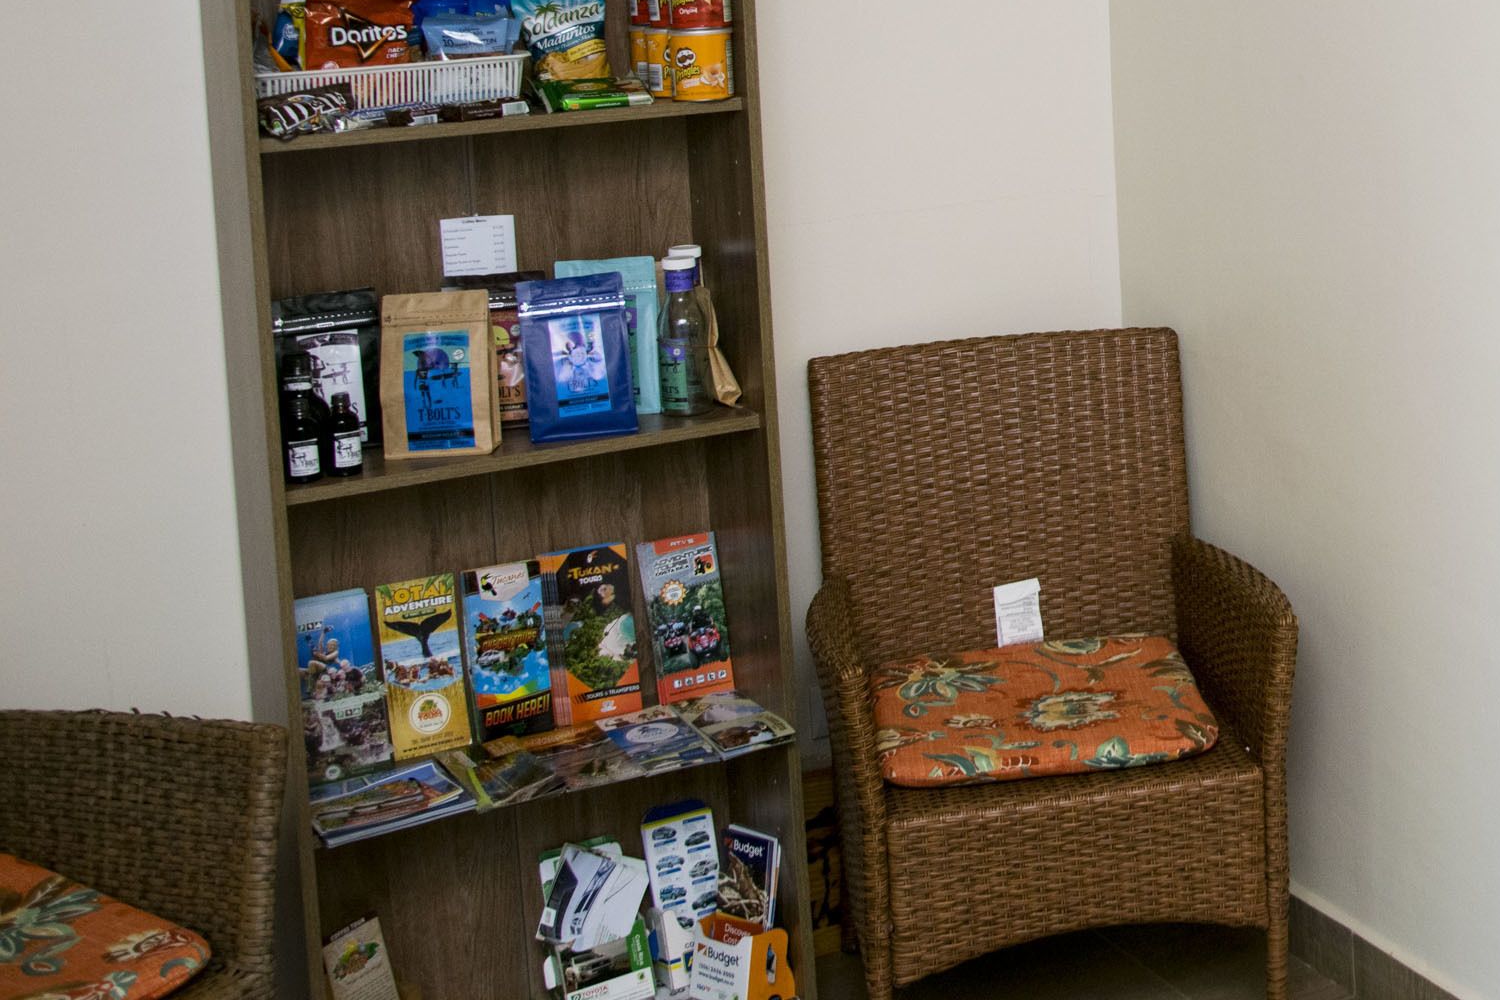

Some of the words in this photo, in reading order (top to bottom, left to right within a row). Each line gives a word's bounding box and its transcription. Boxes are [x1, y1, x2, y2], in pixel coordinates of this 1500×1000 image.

[522, 2, 600, 38] Soldanza
[331, 24, 408, 47] Doritos
[537, 24, 596, 51] Maduritos
[578, 575, 603, 585] TOURS
[382, 583, 452, 606] TOTAL
[384, 595, 454, 616] ADVENTURE
[586, 690, 604, 700] TOURS
[608, 683, 641, 696] TRANSFERS
[485, 705, 514, 728] BOOK
[733, 840, 764, 858] Budget
[707, 946, 740, 968] Budget
[581, 984, 609, 998] TOYOTA
